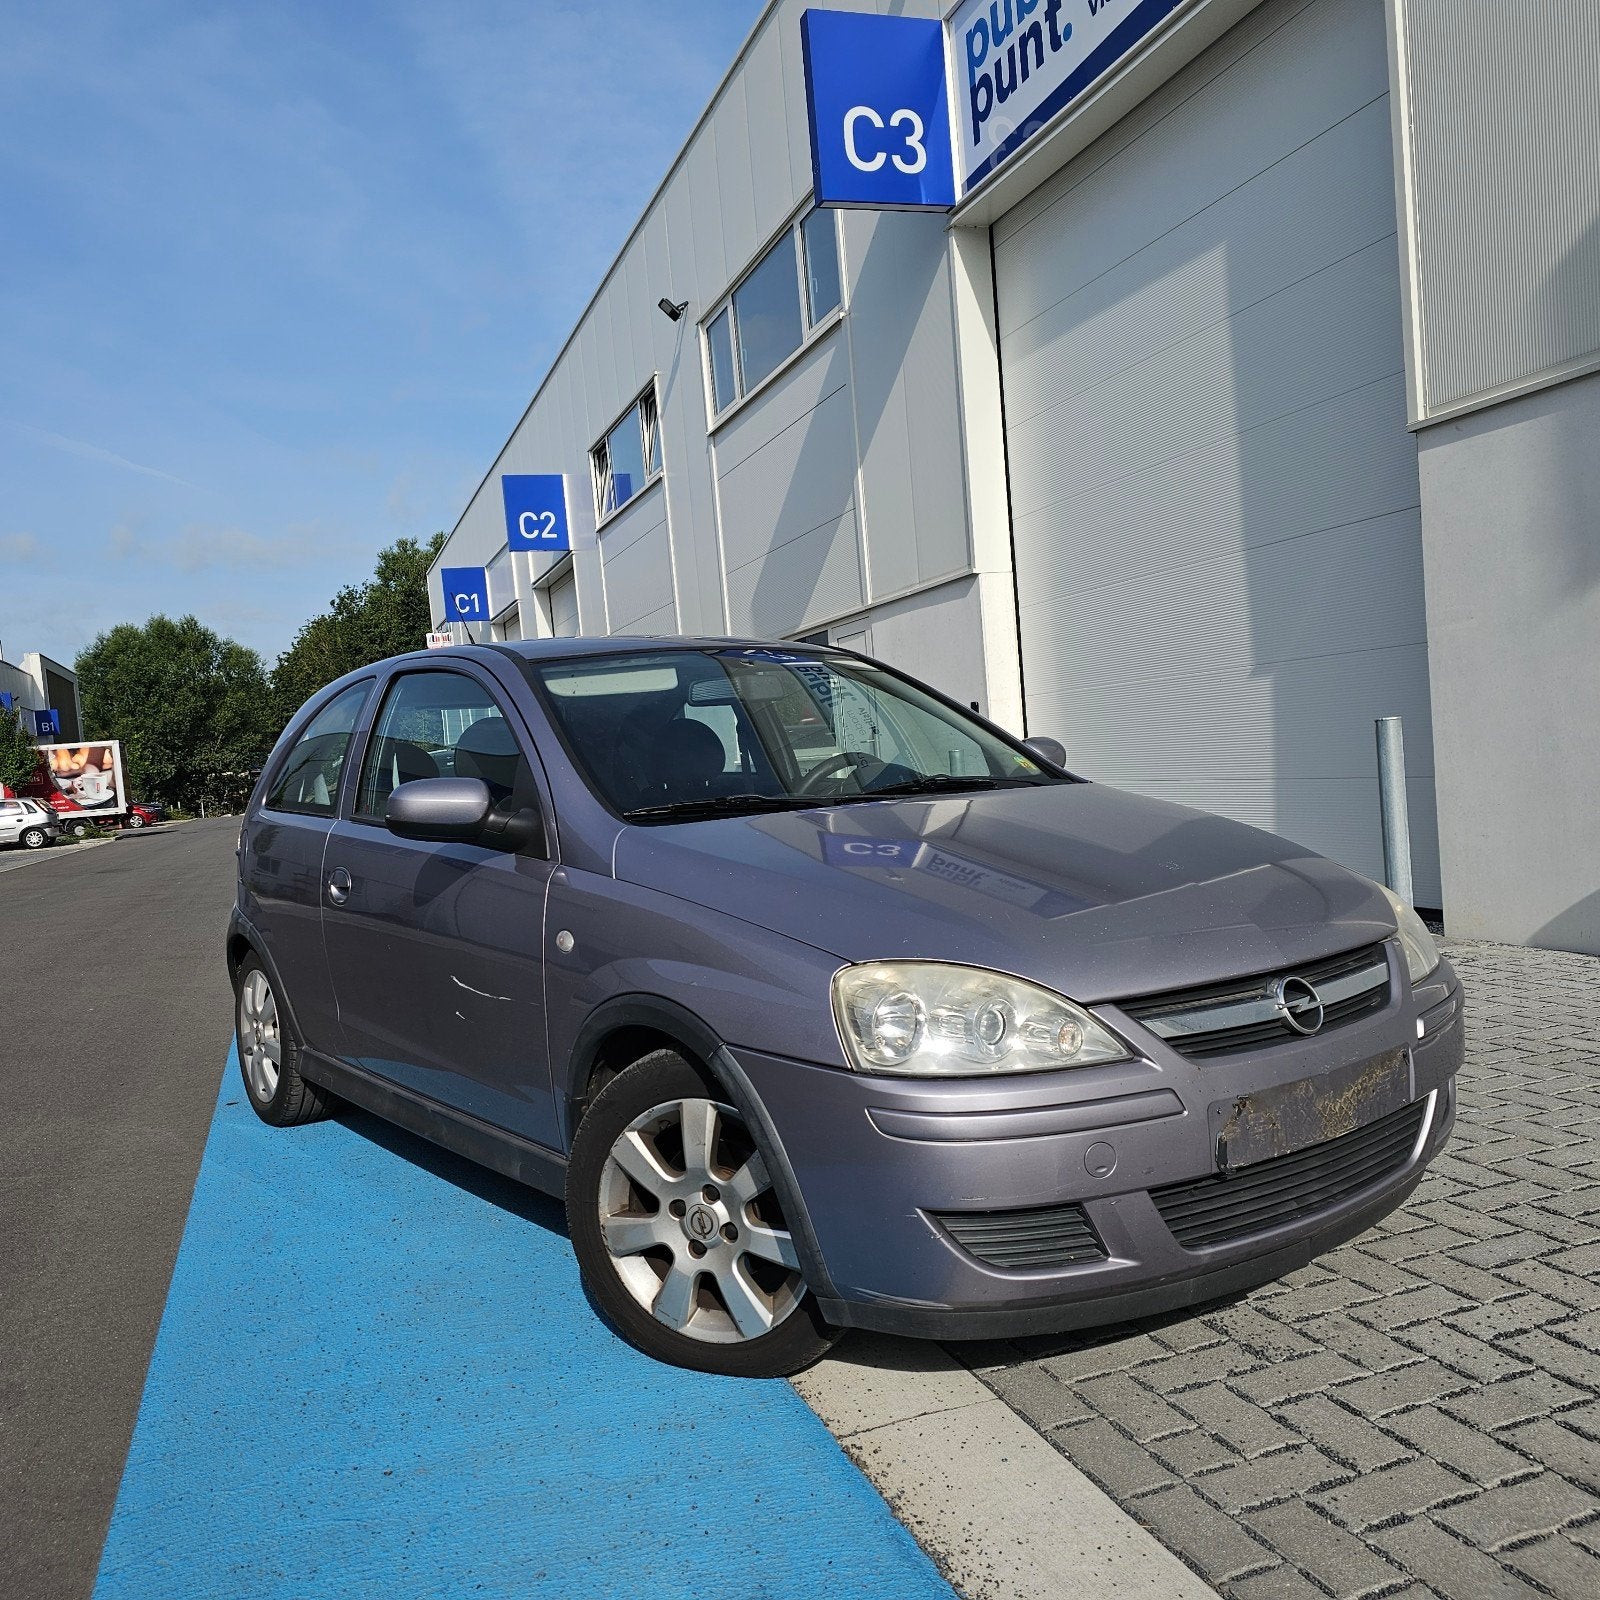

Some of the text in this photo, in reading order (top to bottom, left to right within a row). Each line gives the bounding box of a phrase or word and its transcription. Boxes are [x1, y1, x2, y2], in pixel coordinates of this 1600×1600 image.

[970, 0, 1073, 147] punt.
[843, 106, 927, 174] C3
[519, 511, 558, 539] C2
[455, 593, 480, 613] C1
[41, 722, 55, 732] B1
